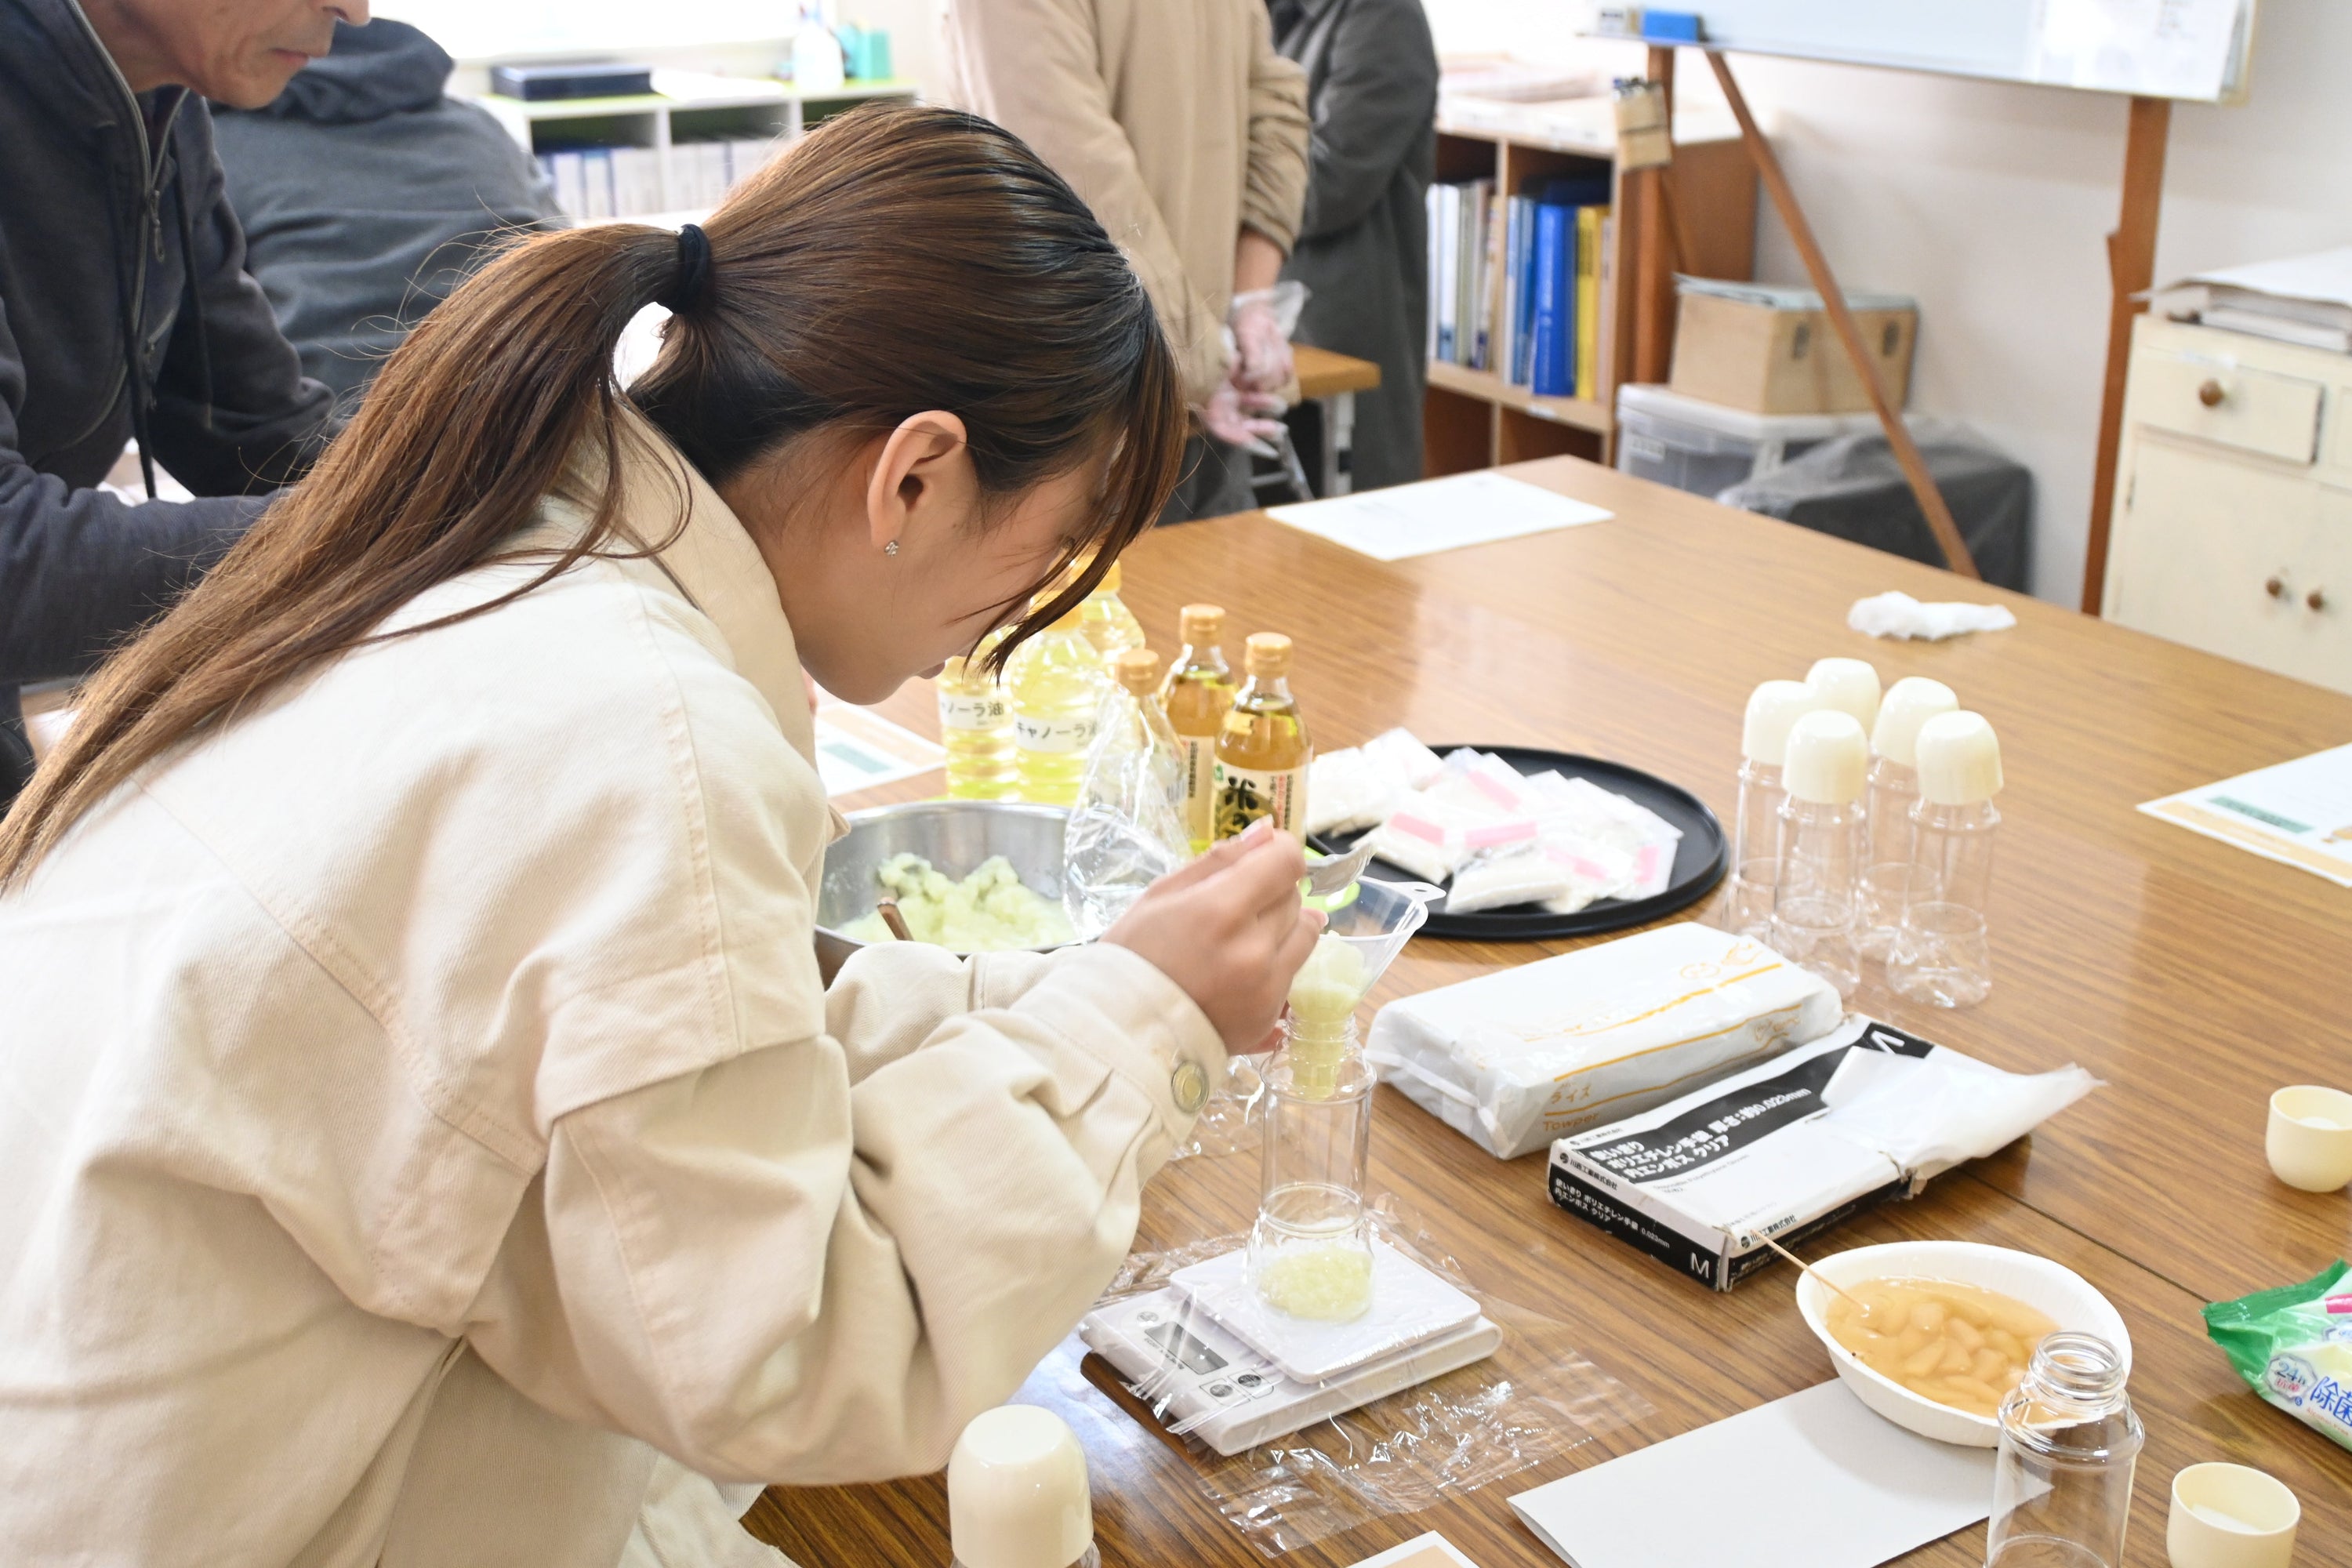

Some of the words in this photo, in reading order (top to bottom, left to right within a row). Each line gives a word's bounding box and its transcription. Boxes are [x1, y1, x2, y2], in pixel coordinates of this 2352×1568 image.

[942, 702, 1004, 717] ノーラ油
[1693, 1134, 1730, 1158] クリア
[1592, 1208, 1611, 1222] クリア
[1640, 1227, 1670, 1249] 0.023mm
[1690, 1252, 1710, 1279] M
